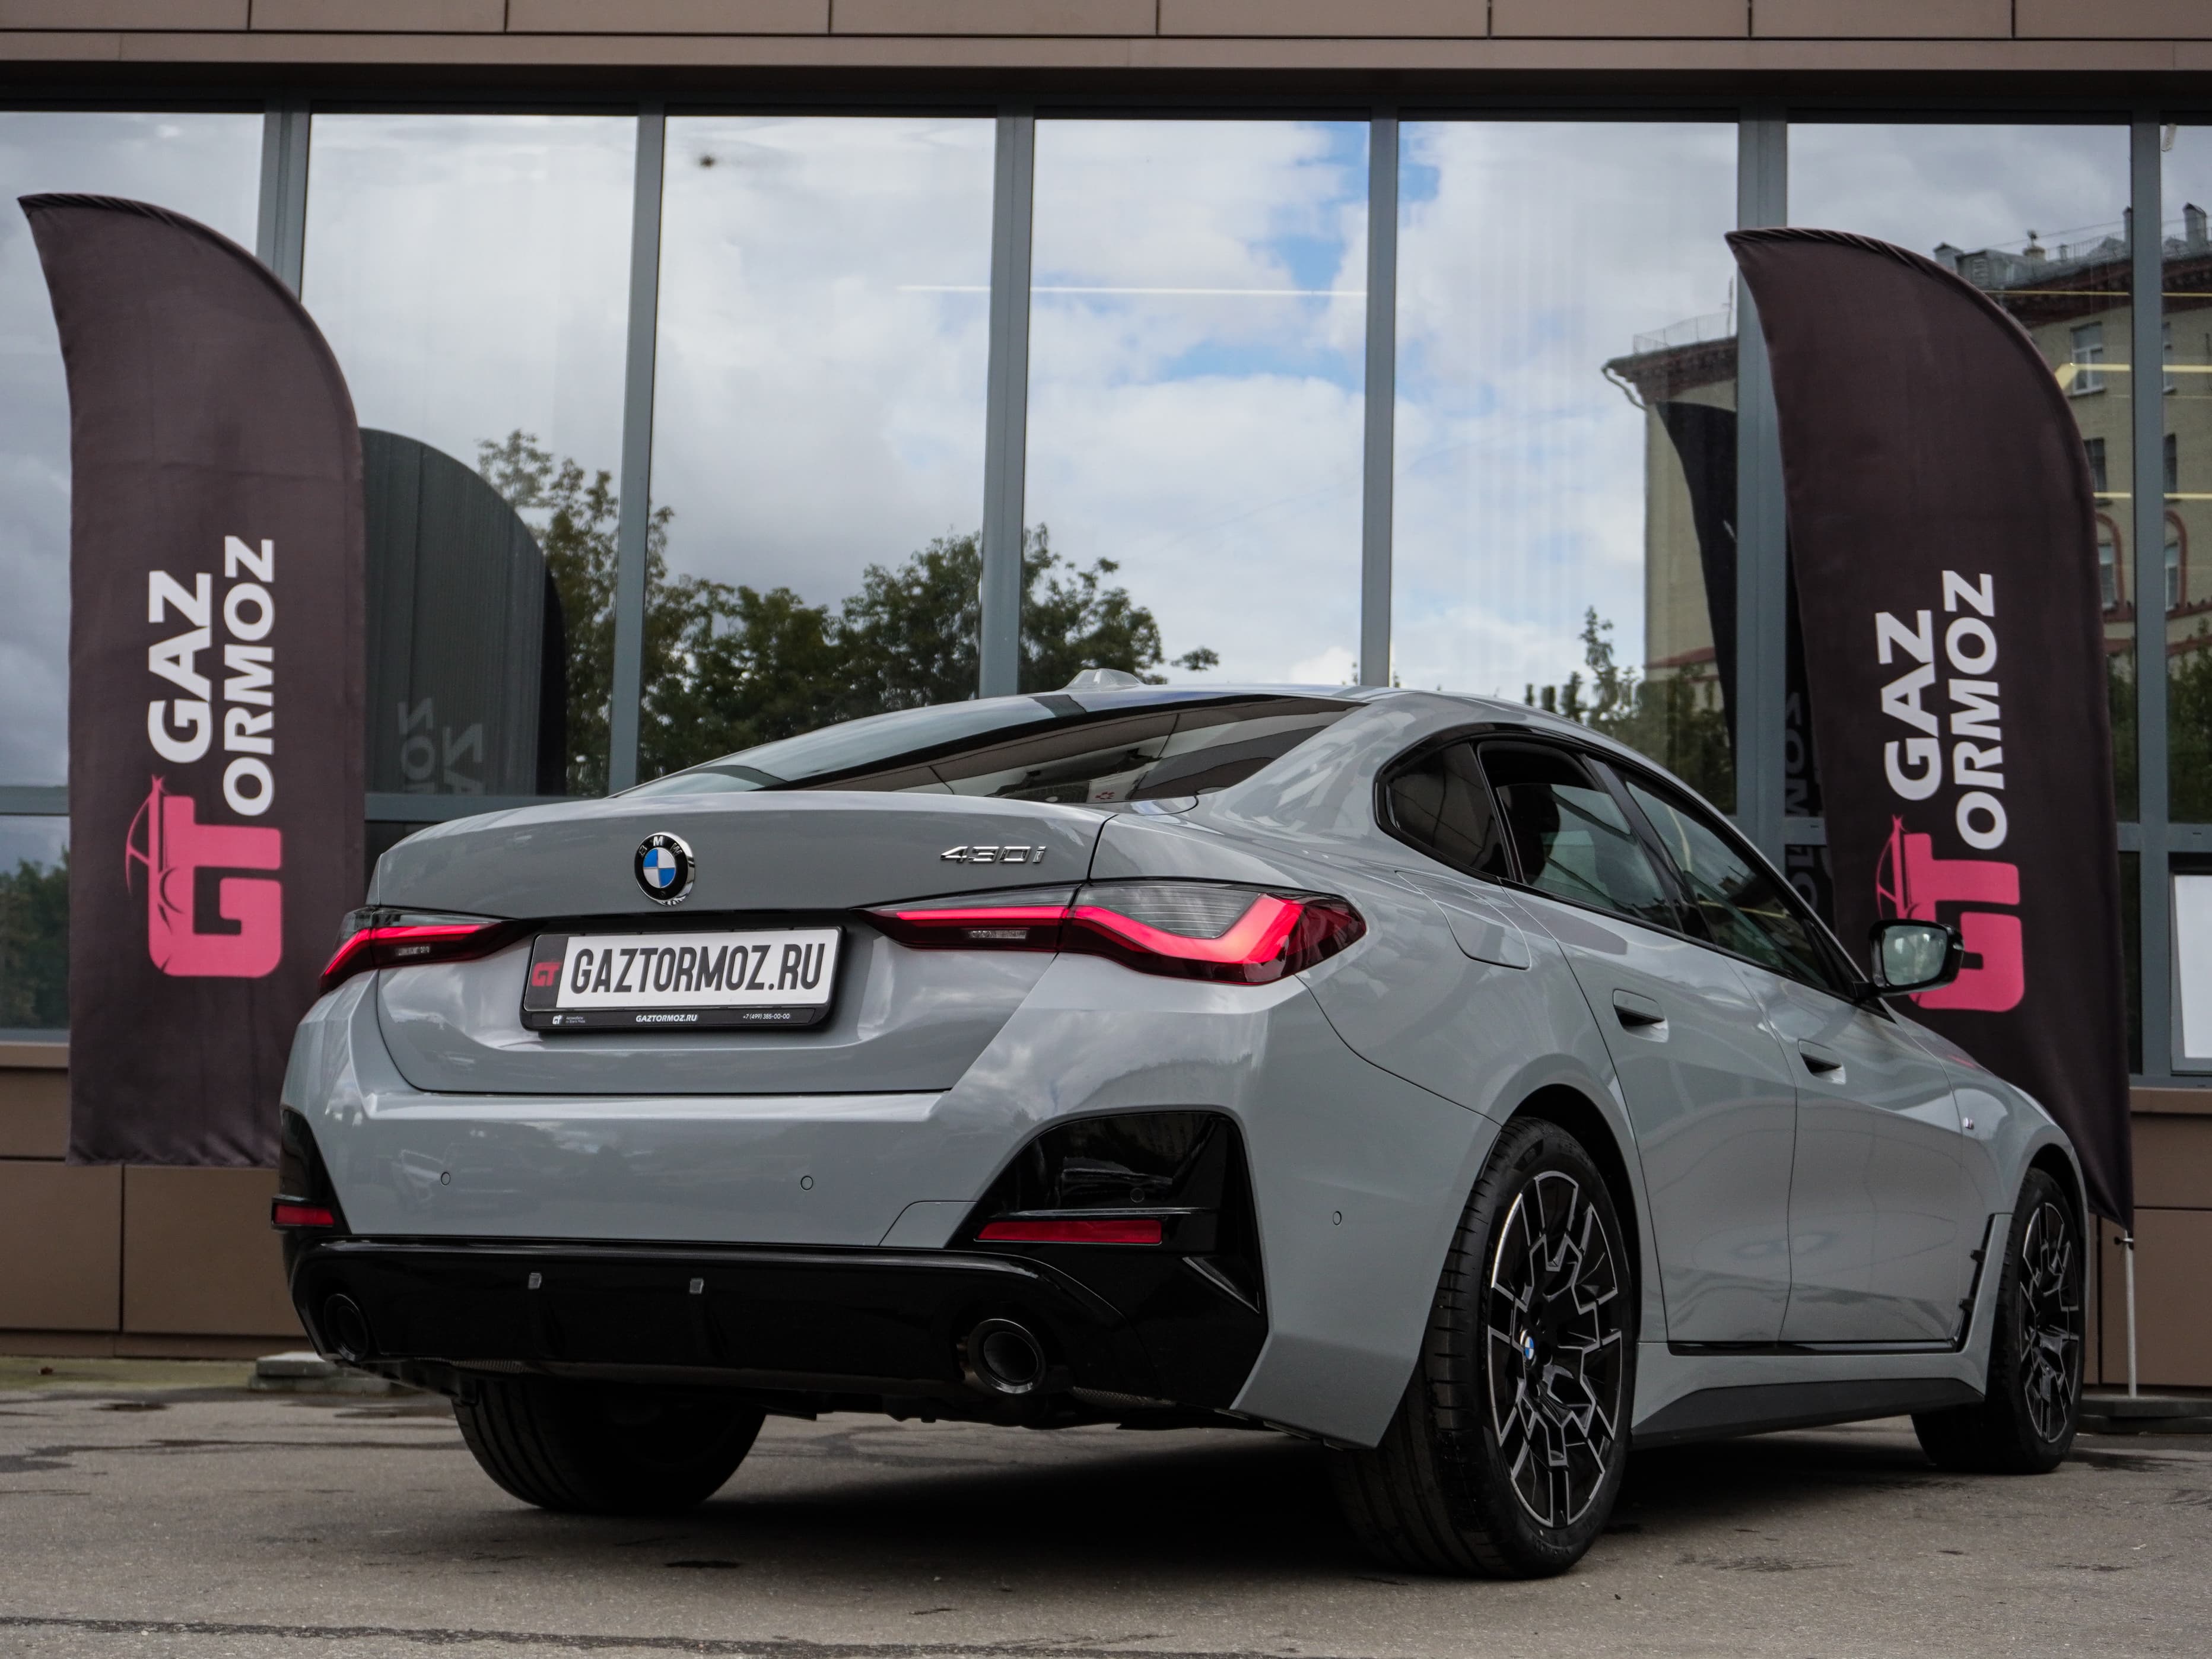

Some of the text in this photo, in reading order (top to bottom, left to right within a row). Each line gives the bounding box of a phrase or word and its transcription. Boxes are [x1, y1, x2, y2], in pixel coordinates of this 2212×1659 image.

[148, 571, 211, 762] GAZ
[223, 536, 274, 816] ORMOZ
[1876, 610, 1942, 800] GAZ
[1942, 570, 2008, 850] ORMOZ
[139, 779, 282, 978] GT
[940, 846, 1047, 863] 430i
[531, 961, 561, 987] GT
[570, 943, 825, 994] GAZTORMOZ.RU
[635, 1014, 697, 1022] GAZTORMOZ.RU
